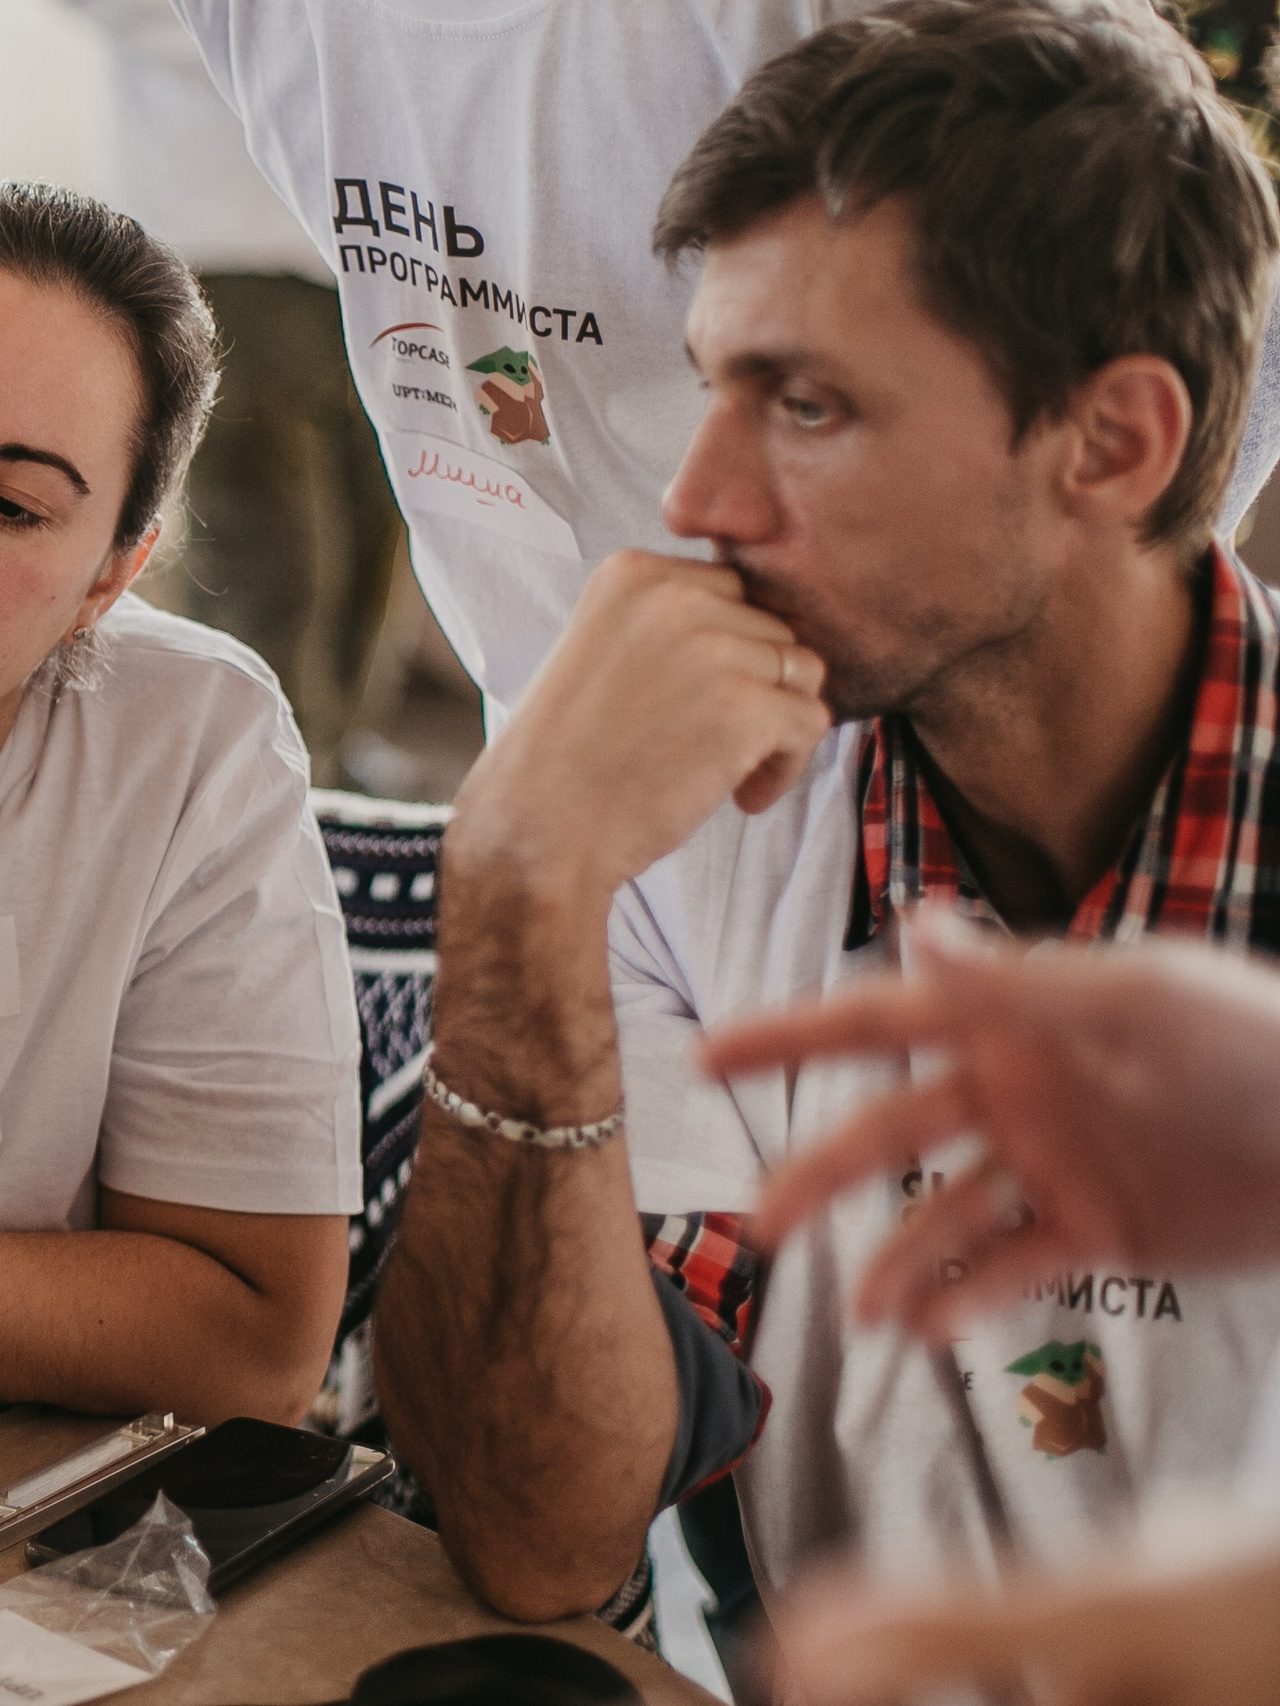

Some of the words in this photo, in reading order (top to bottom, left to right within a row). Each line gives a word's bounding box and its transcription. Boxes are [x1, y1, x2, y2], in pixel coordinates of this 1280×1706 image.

[333, 178, 485, 258] ДЕНЬ
[339, 244, 604, 346] ПРОГРАММИСТА
[407, 449, 525, 509] Миша
